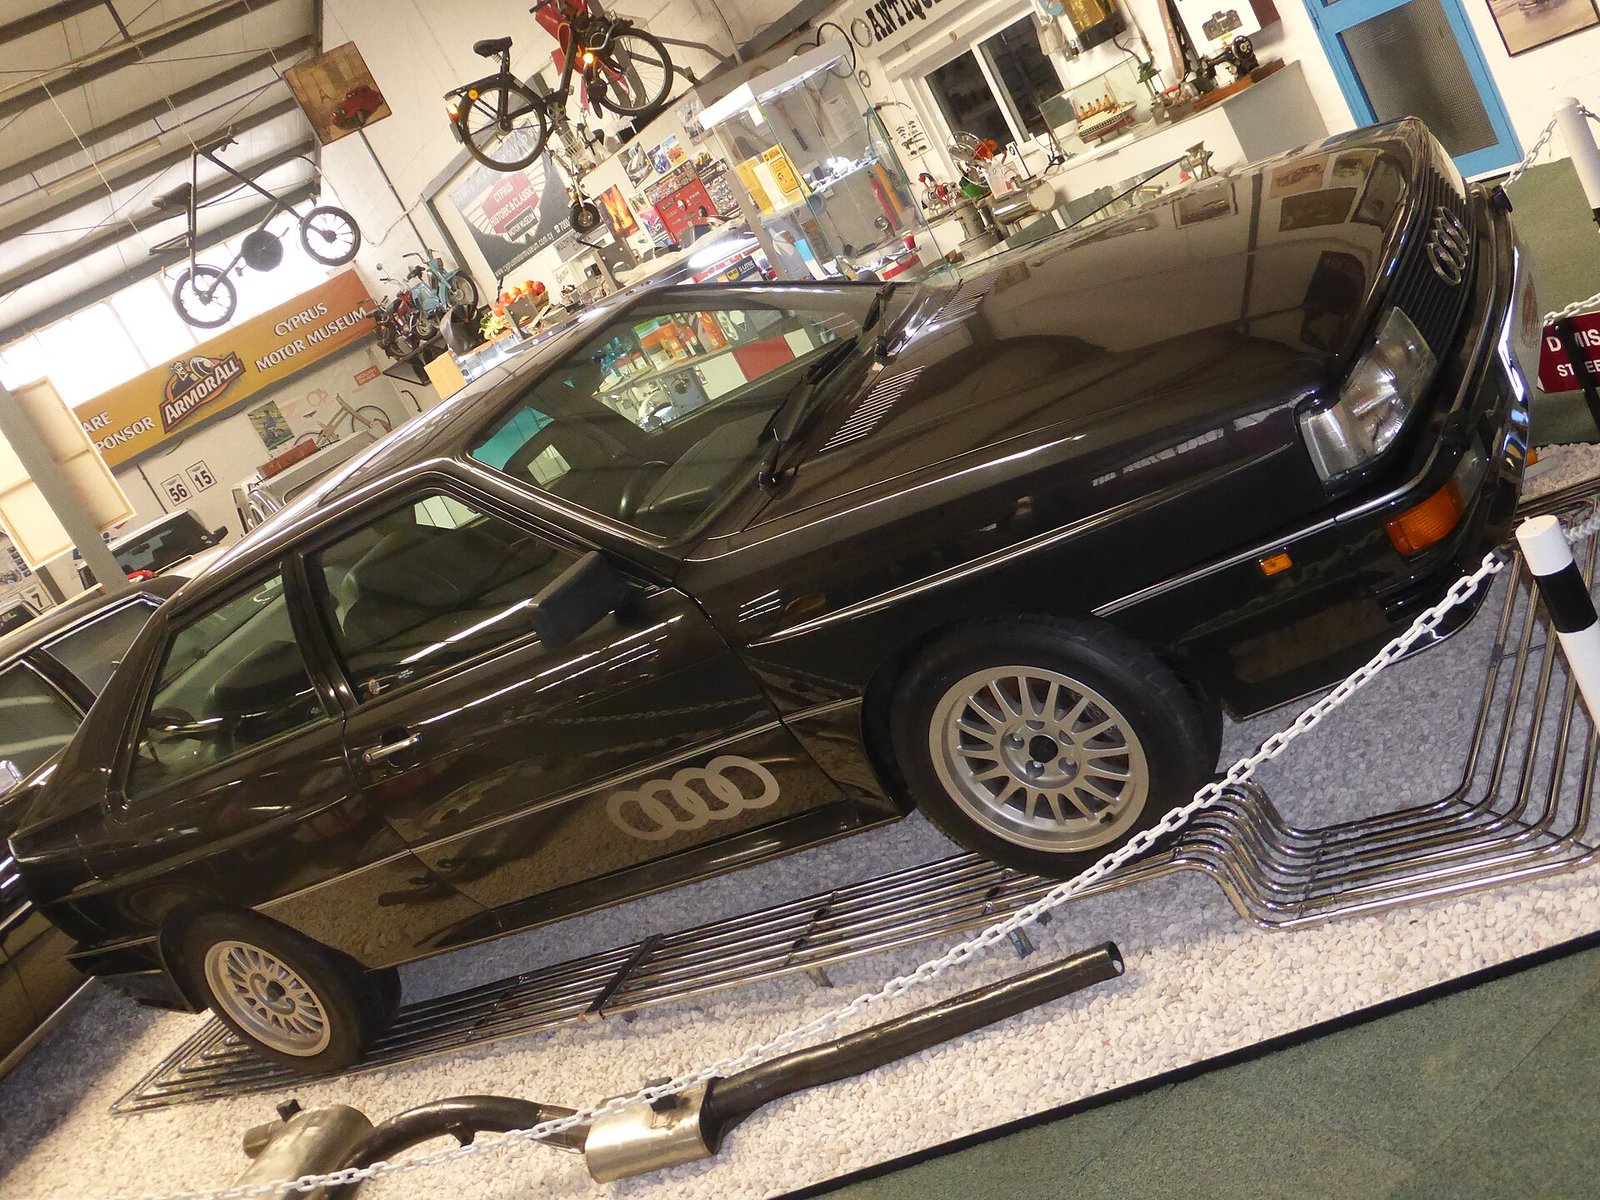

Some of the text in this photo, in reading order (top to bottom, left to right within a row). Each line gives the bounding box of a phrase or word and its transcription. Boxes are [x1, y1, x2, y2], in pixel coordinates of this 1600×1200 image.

[865, 0, 940, 42] ANTIQ
[492, 181, 513, 202] CYPRUS
[488, 204, 512, 226] HISTORIC
[511, 184, 535, 208] CLASSIC
[507, 212, 535, 236] MOTOR MUSEUM
[274, 302, 328, 336] CYPRUS
[255, 307, 368, 372] MOTOR MUSEUM
[1557, 360, 1600, 377] STEE
[82, 411, 113, 433] ARE
[94, 416, 156, 454] PONSOR
[194, 469, 213, 488] 15
[168, 483, 188, 502] 56
[31, 592, 44, 608] 7
